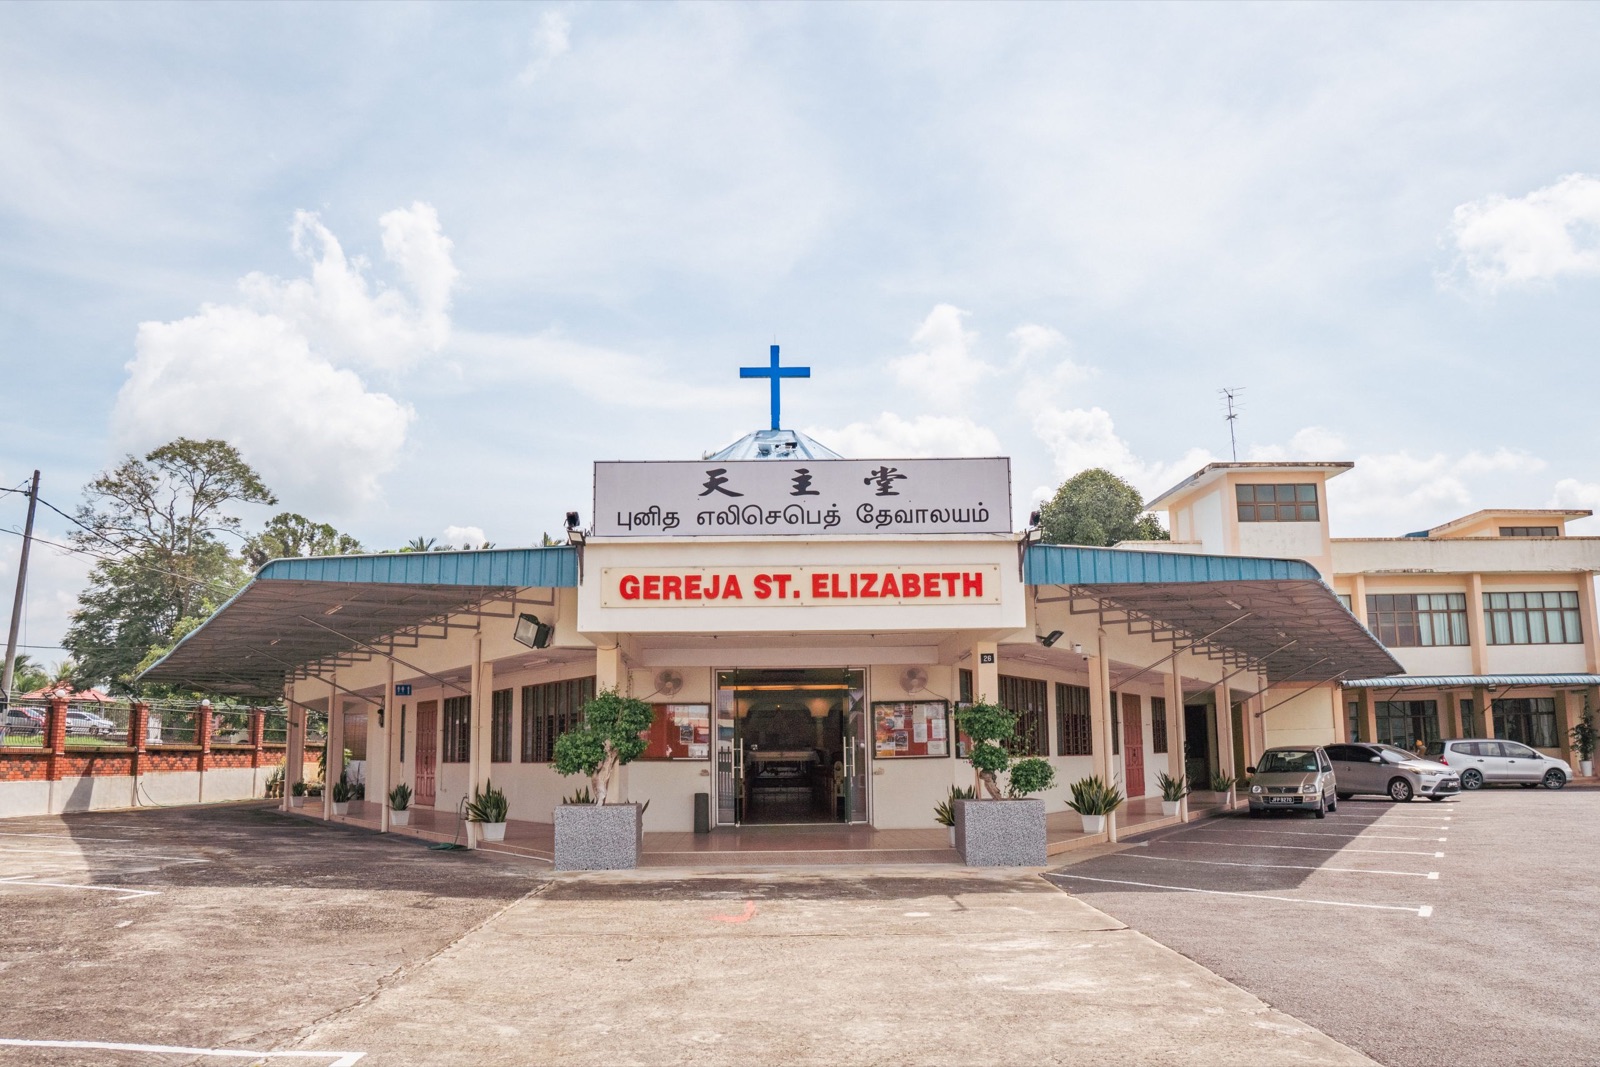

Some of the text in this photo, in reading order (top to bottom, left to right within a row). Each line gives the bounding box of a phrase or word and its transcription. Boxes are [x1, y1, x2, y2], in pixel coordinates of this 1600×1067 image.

[699, 466, 907, 497] 天主堂
[618, 502, 990, 531] புனித எலிசெபெத் தேவாலயம்
[620, 573, 983, 600] GEREJA ST. ELIZABETH
